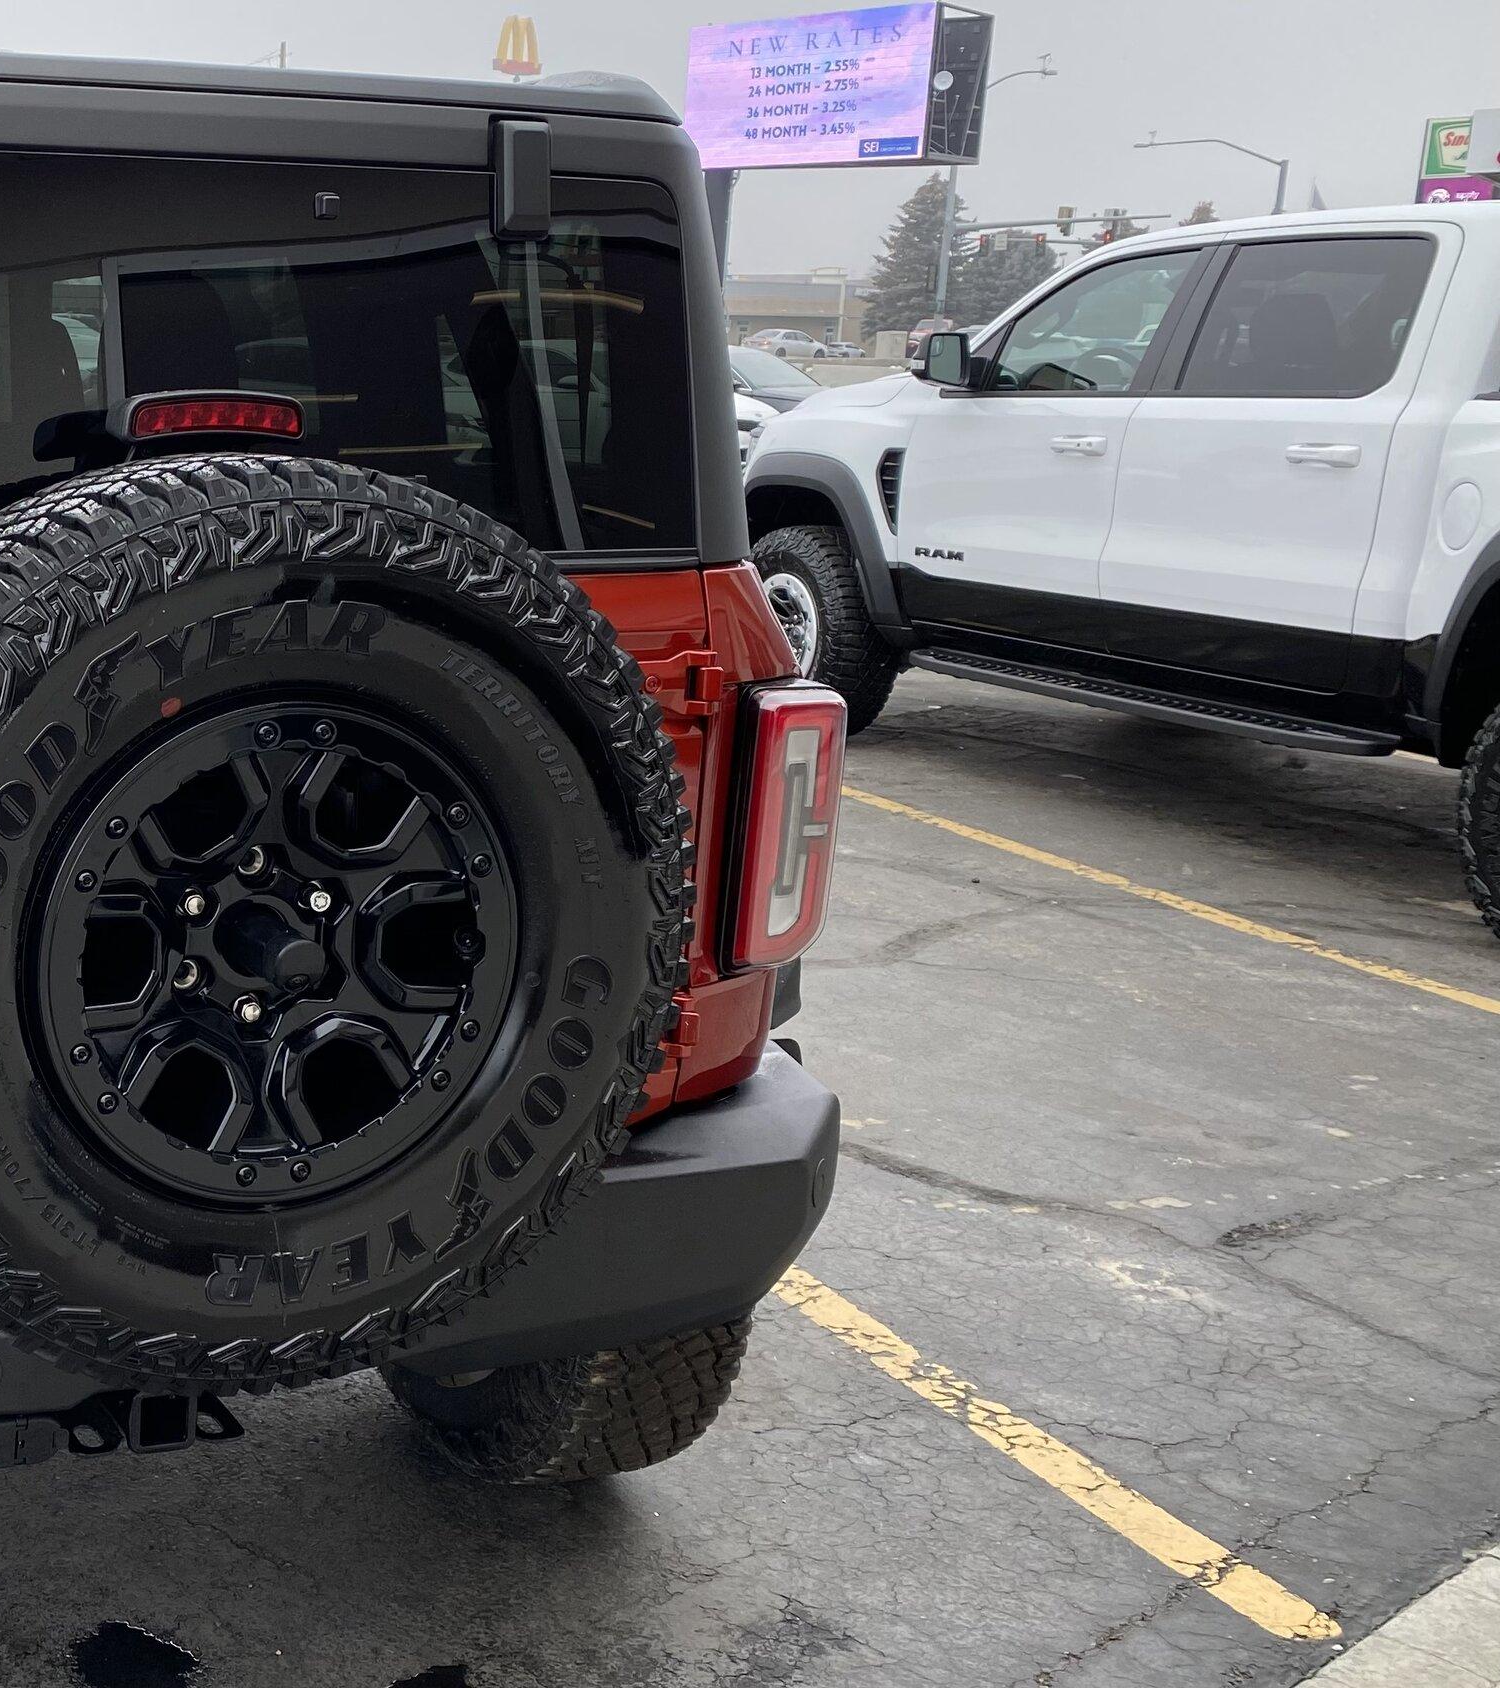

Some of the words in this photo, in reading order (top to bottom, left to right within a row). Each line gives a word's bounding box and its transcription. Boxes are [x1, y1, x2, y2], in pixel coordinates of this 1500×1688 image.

[728, 35, 788, 58] NEW
[806, 23, 902, 50] RATES
[750, 67, 762, 79] 13
[765, 62, 811, 77] MONTH
[824, 58, 860, 73] 2.55%
[748, 86, 762, 98] 24
[765, 81, 811, 96] MONTH
[824, 78, 860, 92] 2.75%
[747, 107, 760, 118] 36
[763, 103, 808, 117] MONTH
[821, 99, 857, 113] 3.25%
[745, 128, 758, 140] 48
[761, 124, 807, 139] MONTH
[820, 121, 856, 135] 3.45%
[914, 546, 964, 561] RAM
[437, 648, 585, 806] TERRITORY
